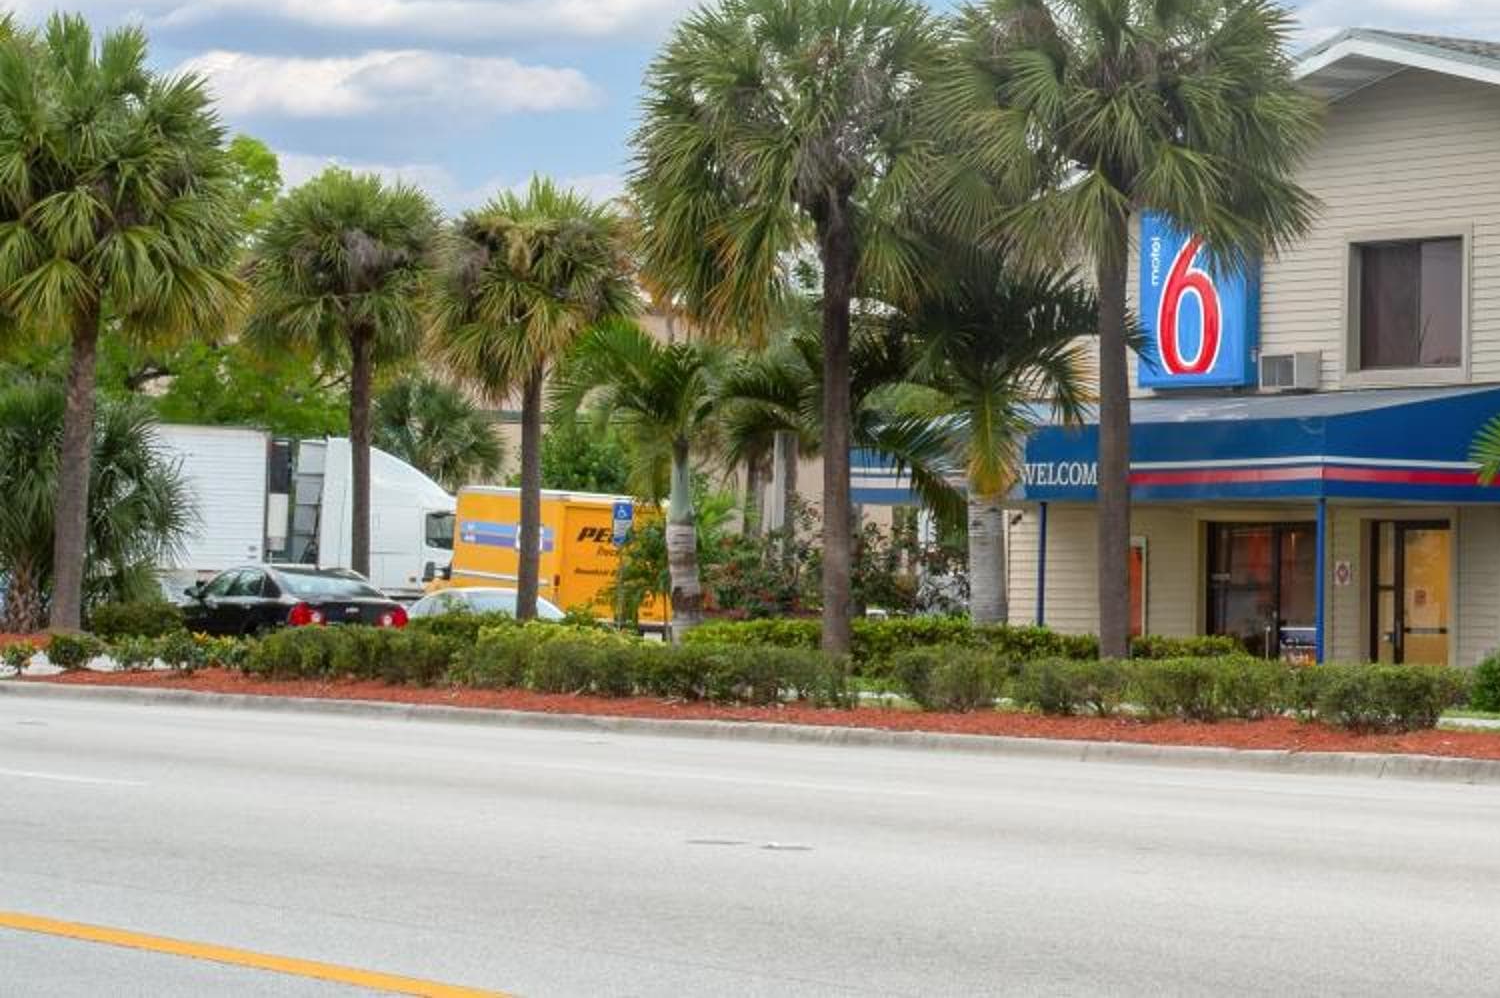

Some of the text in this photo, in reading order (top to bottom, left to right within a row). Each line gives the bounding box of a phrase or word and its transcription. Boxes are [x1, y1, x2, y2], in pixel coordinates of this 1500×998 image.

[1151, 236, 1161, 287] motel
[1157, 233, 1222, 375] 6
[1020, 462, 1099, 486] WELCOM
